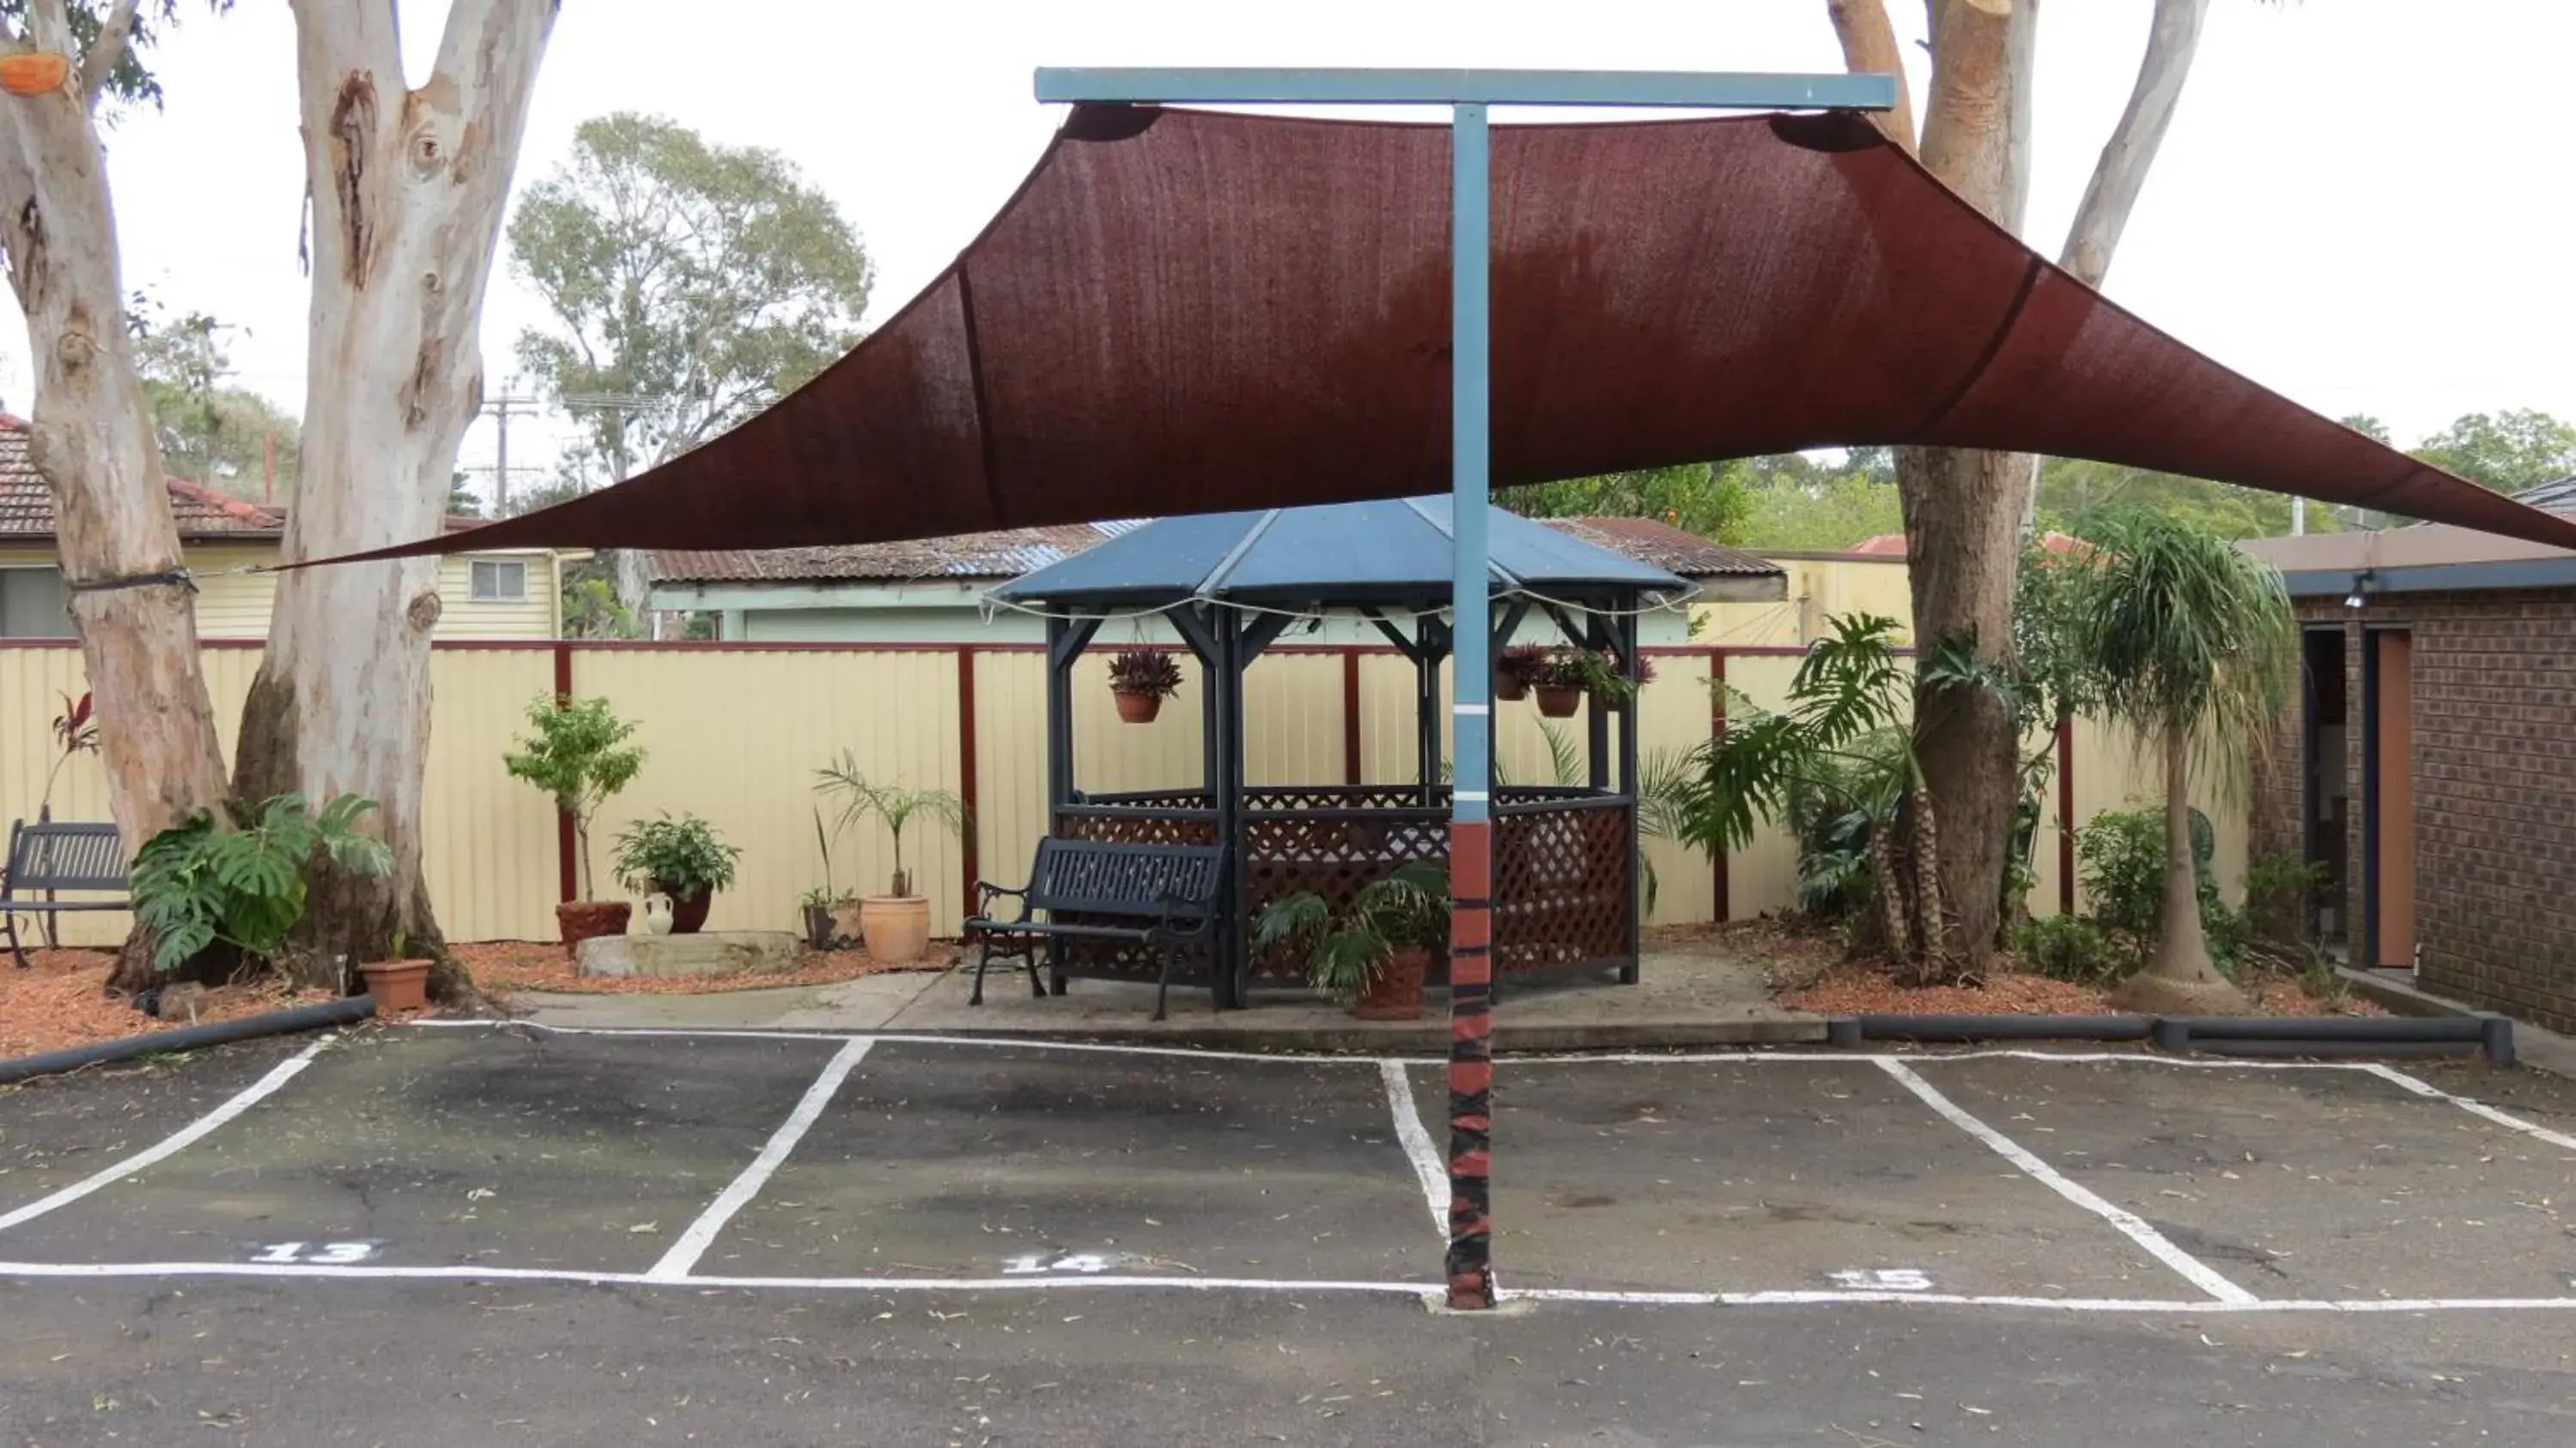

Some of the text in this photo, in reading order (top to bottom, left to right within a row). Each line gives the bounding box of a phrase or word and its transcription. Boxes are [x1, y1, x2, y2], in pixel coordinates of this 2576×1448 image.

[250, 1242, 371, 1262] 13
[1003, 1255, 1108, 1273] 14
[1829, 1269, 1933, 1289] 15
